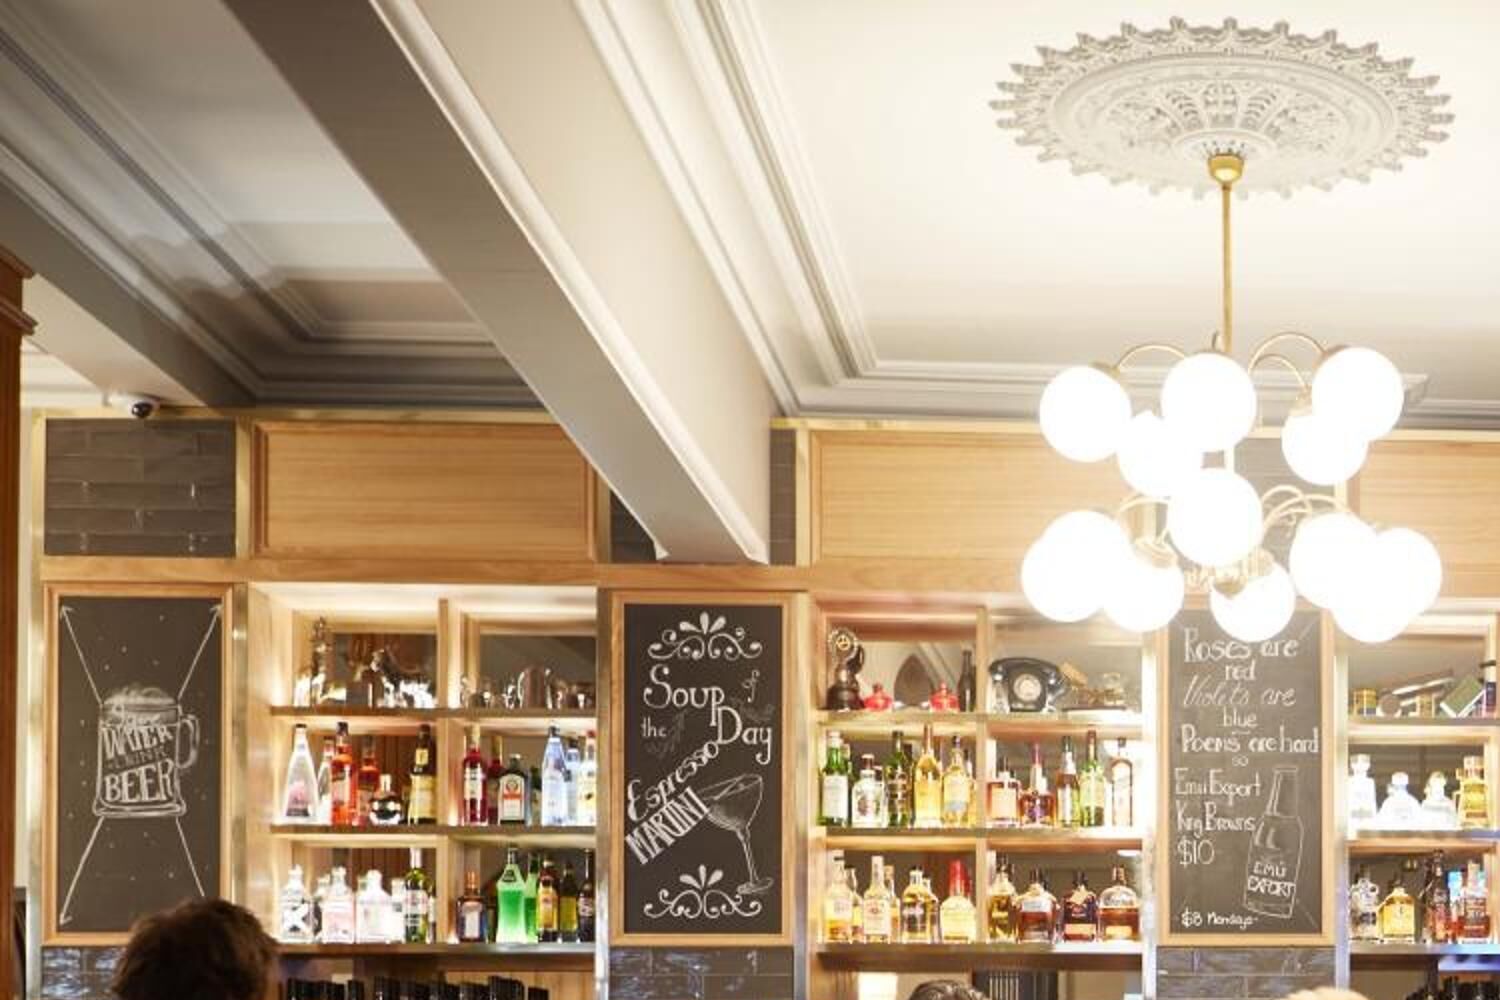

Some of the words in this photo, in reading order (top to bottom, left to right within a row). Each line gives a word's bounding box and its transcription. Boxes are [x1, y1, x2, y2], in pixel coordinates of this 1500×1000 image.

[1184, 627, 1250, 663] Roses
[1260, 640, 1299, 657] are
[1225, 659, 1256, 681] red
[1261, 688, 1297, 706] are
[1222, 705, 1258, 728] blue
[101, 722, 174, 759] WATER
[641, 716, 667, 737] the
[717, 705, 772, 765] Day
[1181, 723, 1241, 753] Poems
[1248, 736, 1279, 753] are
[1280, 723, 1319, 753] hard
[104, 758, 175, 803] BEER
[1174, 767, 1207, 795] Emu
[1209, 768, 1262, 807] Export
[625, 785, 712, 866] MARTINI
[1177, 835, 1215, 868] $10
[1253, 860, 1288, 878] EMU
[1247, 874, 1297, 898] EXPORT
[1181, 906, 1203, 927] $8
